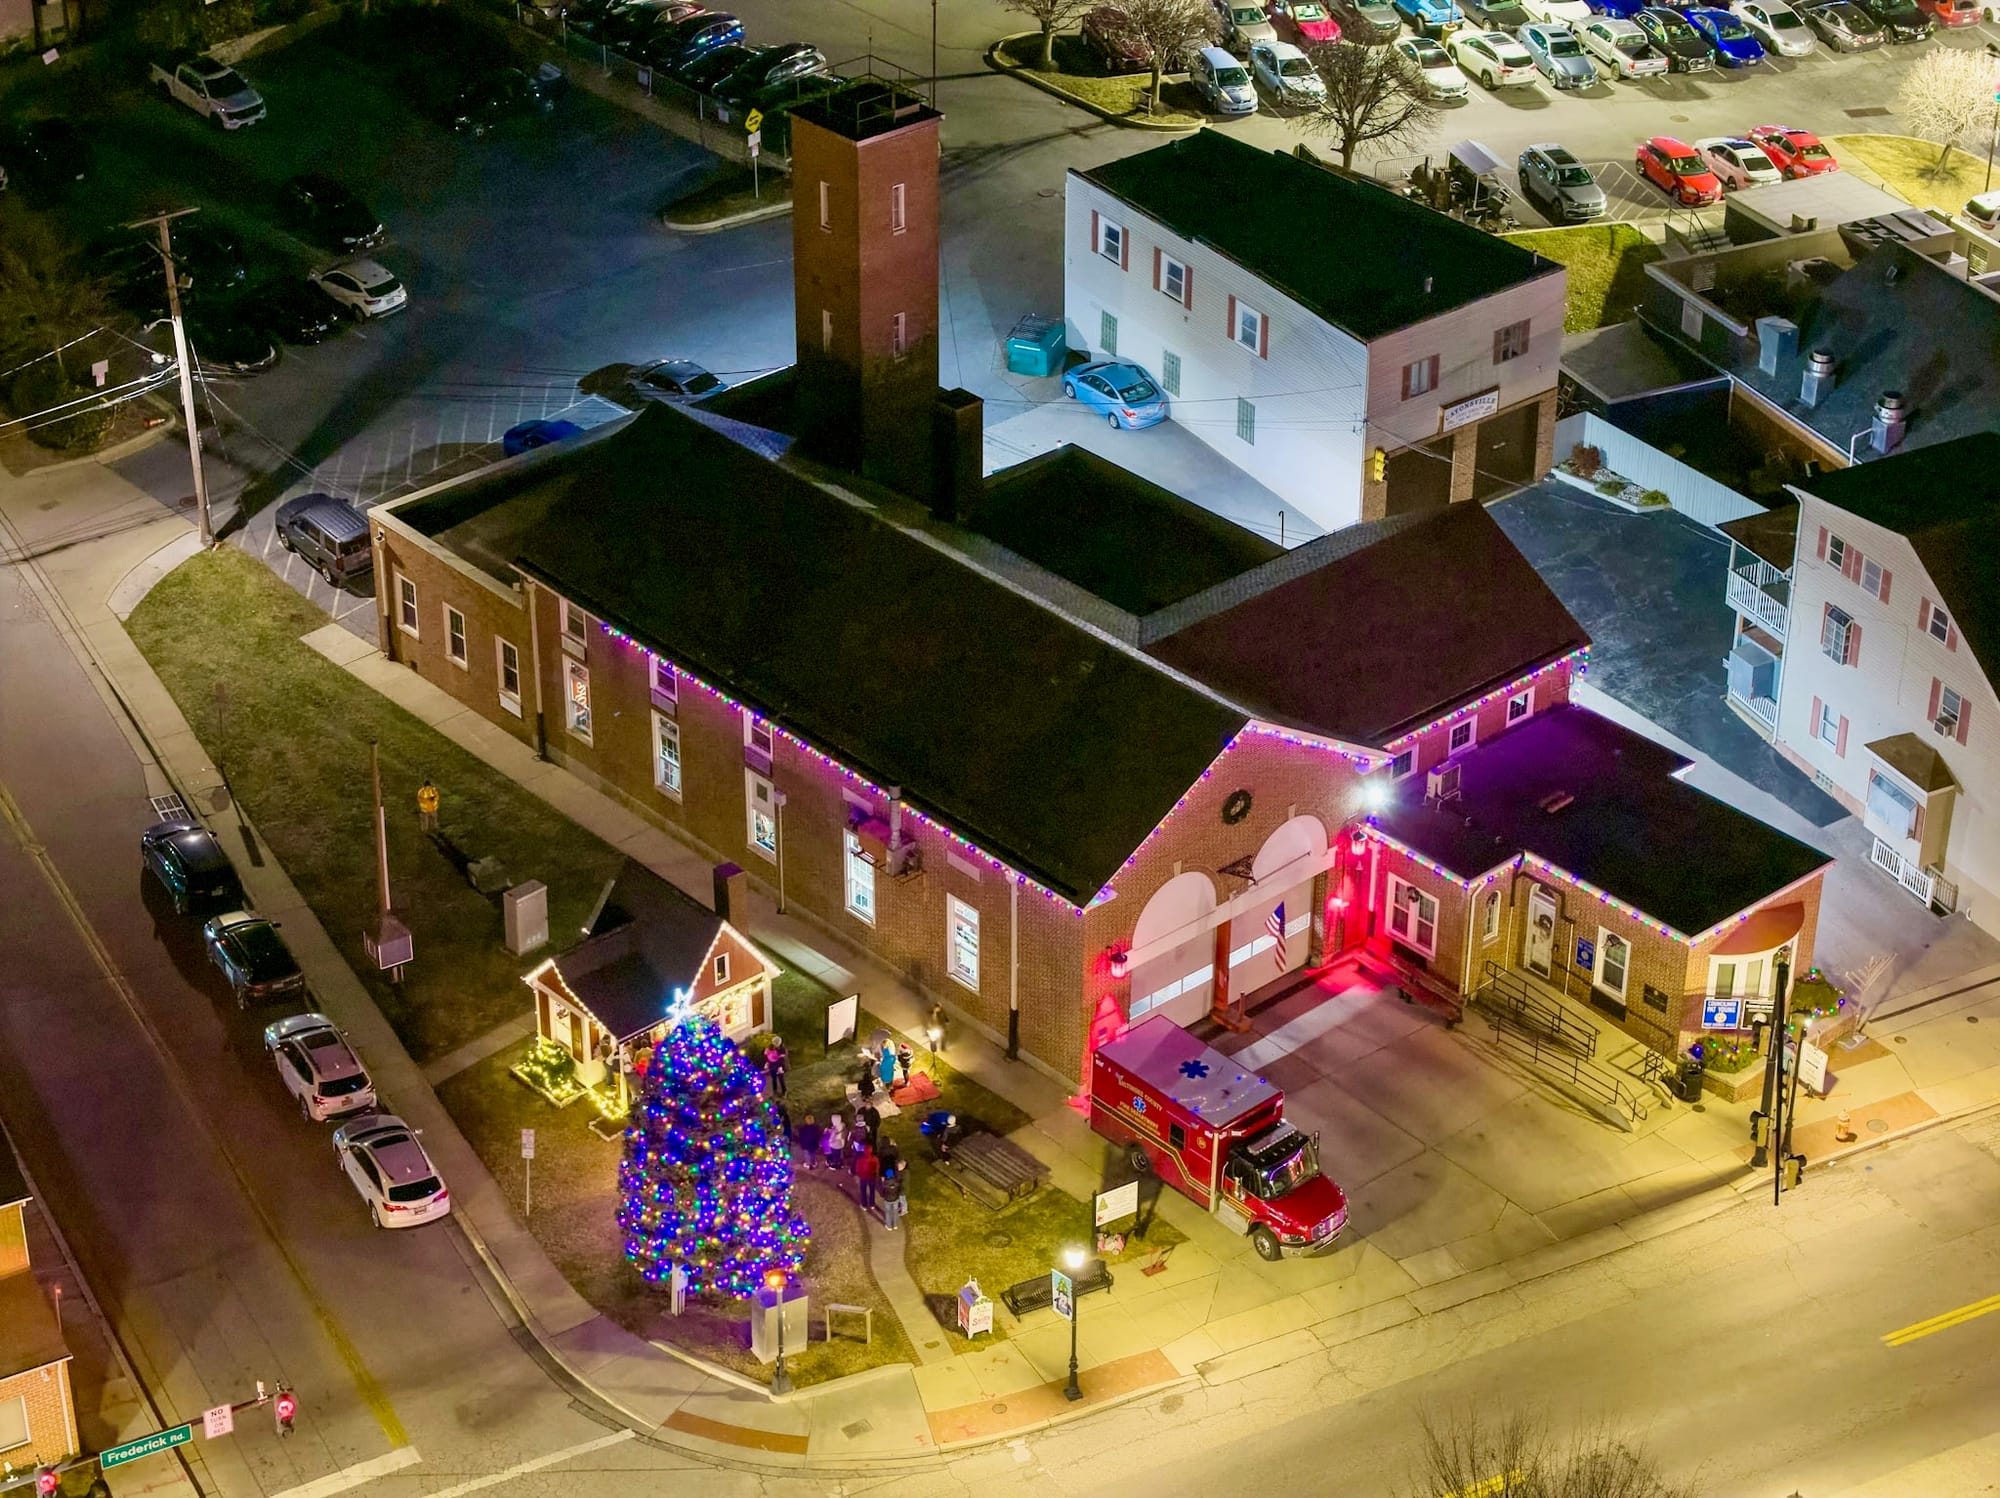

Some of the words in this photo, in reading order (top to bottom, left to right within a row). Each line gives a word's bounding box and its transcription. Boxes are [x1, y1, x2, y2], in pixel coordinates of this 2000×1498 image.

[1445, 397, 1497, 421] CATONSVILLE
[210, 1415, 226, 1423] TURN
[211, 1408, 223, 1417] NO
[107, 1437, 167, 1463] Frederick
[170, 1433, 185, 1443] Rd.
